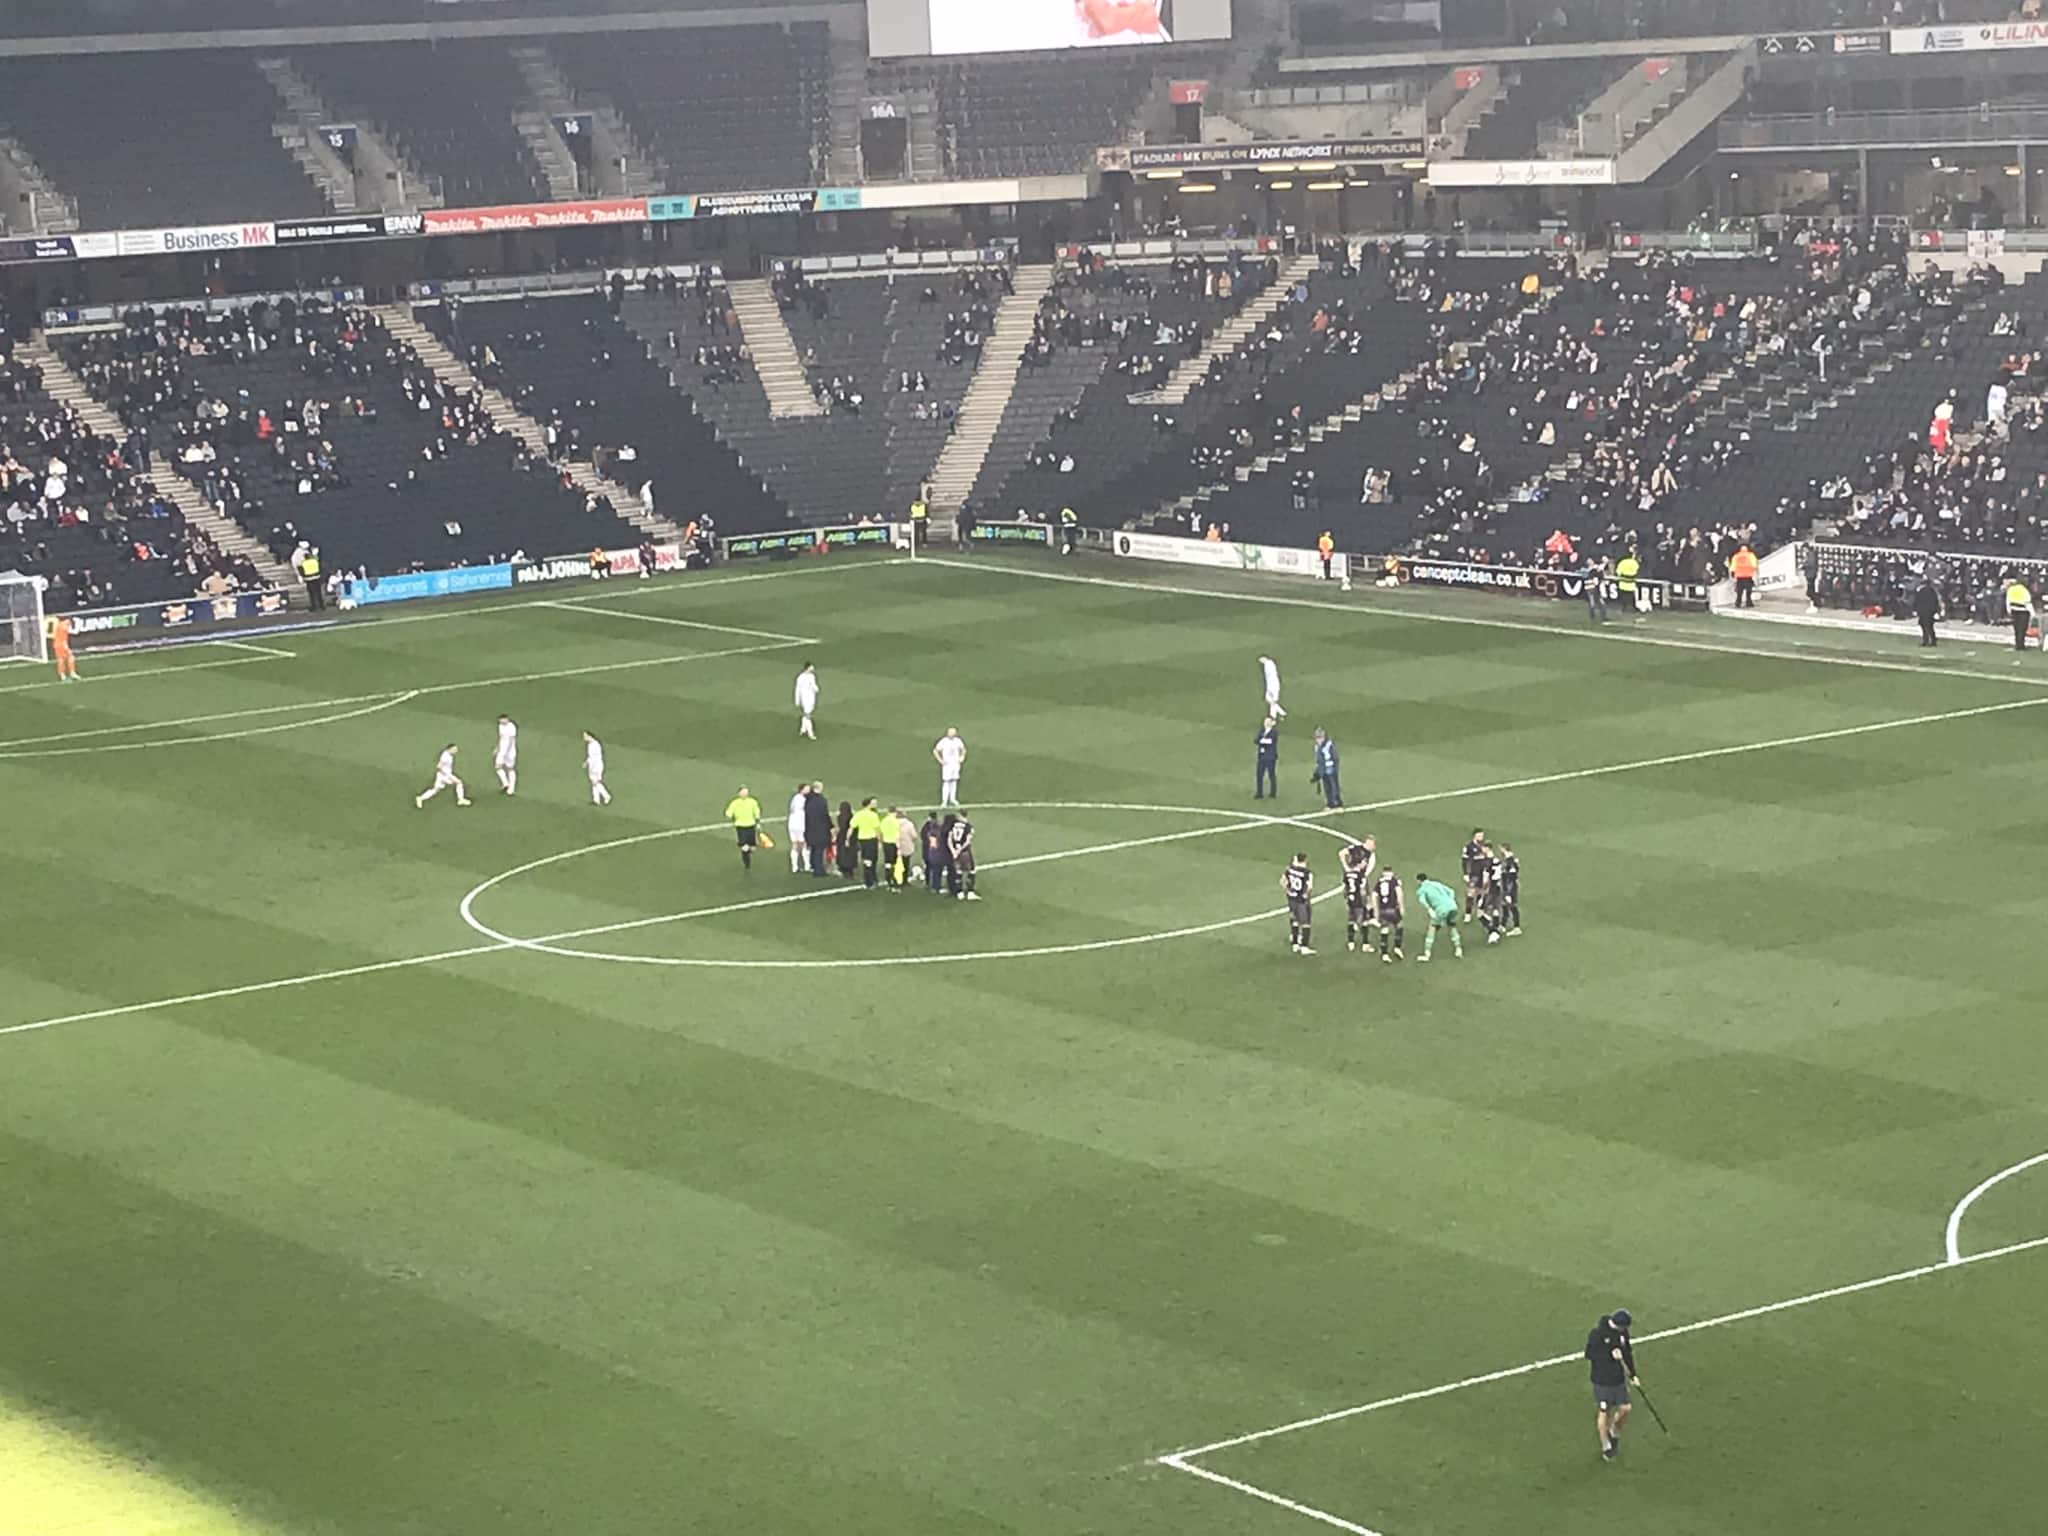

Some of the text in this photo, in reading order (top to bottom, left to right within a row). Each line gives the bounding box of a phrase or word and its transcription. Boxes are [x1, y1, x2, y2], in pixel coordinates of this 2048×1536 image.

[1250, 148, 1280, 160] LYNX
[384, 215, 422, 232] EMW
[164, 232, 239, 249] Business
[242, 225, 270, 245] MK
[1412, 565, 1531, 589] conceptclean.co.uk
